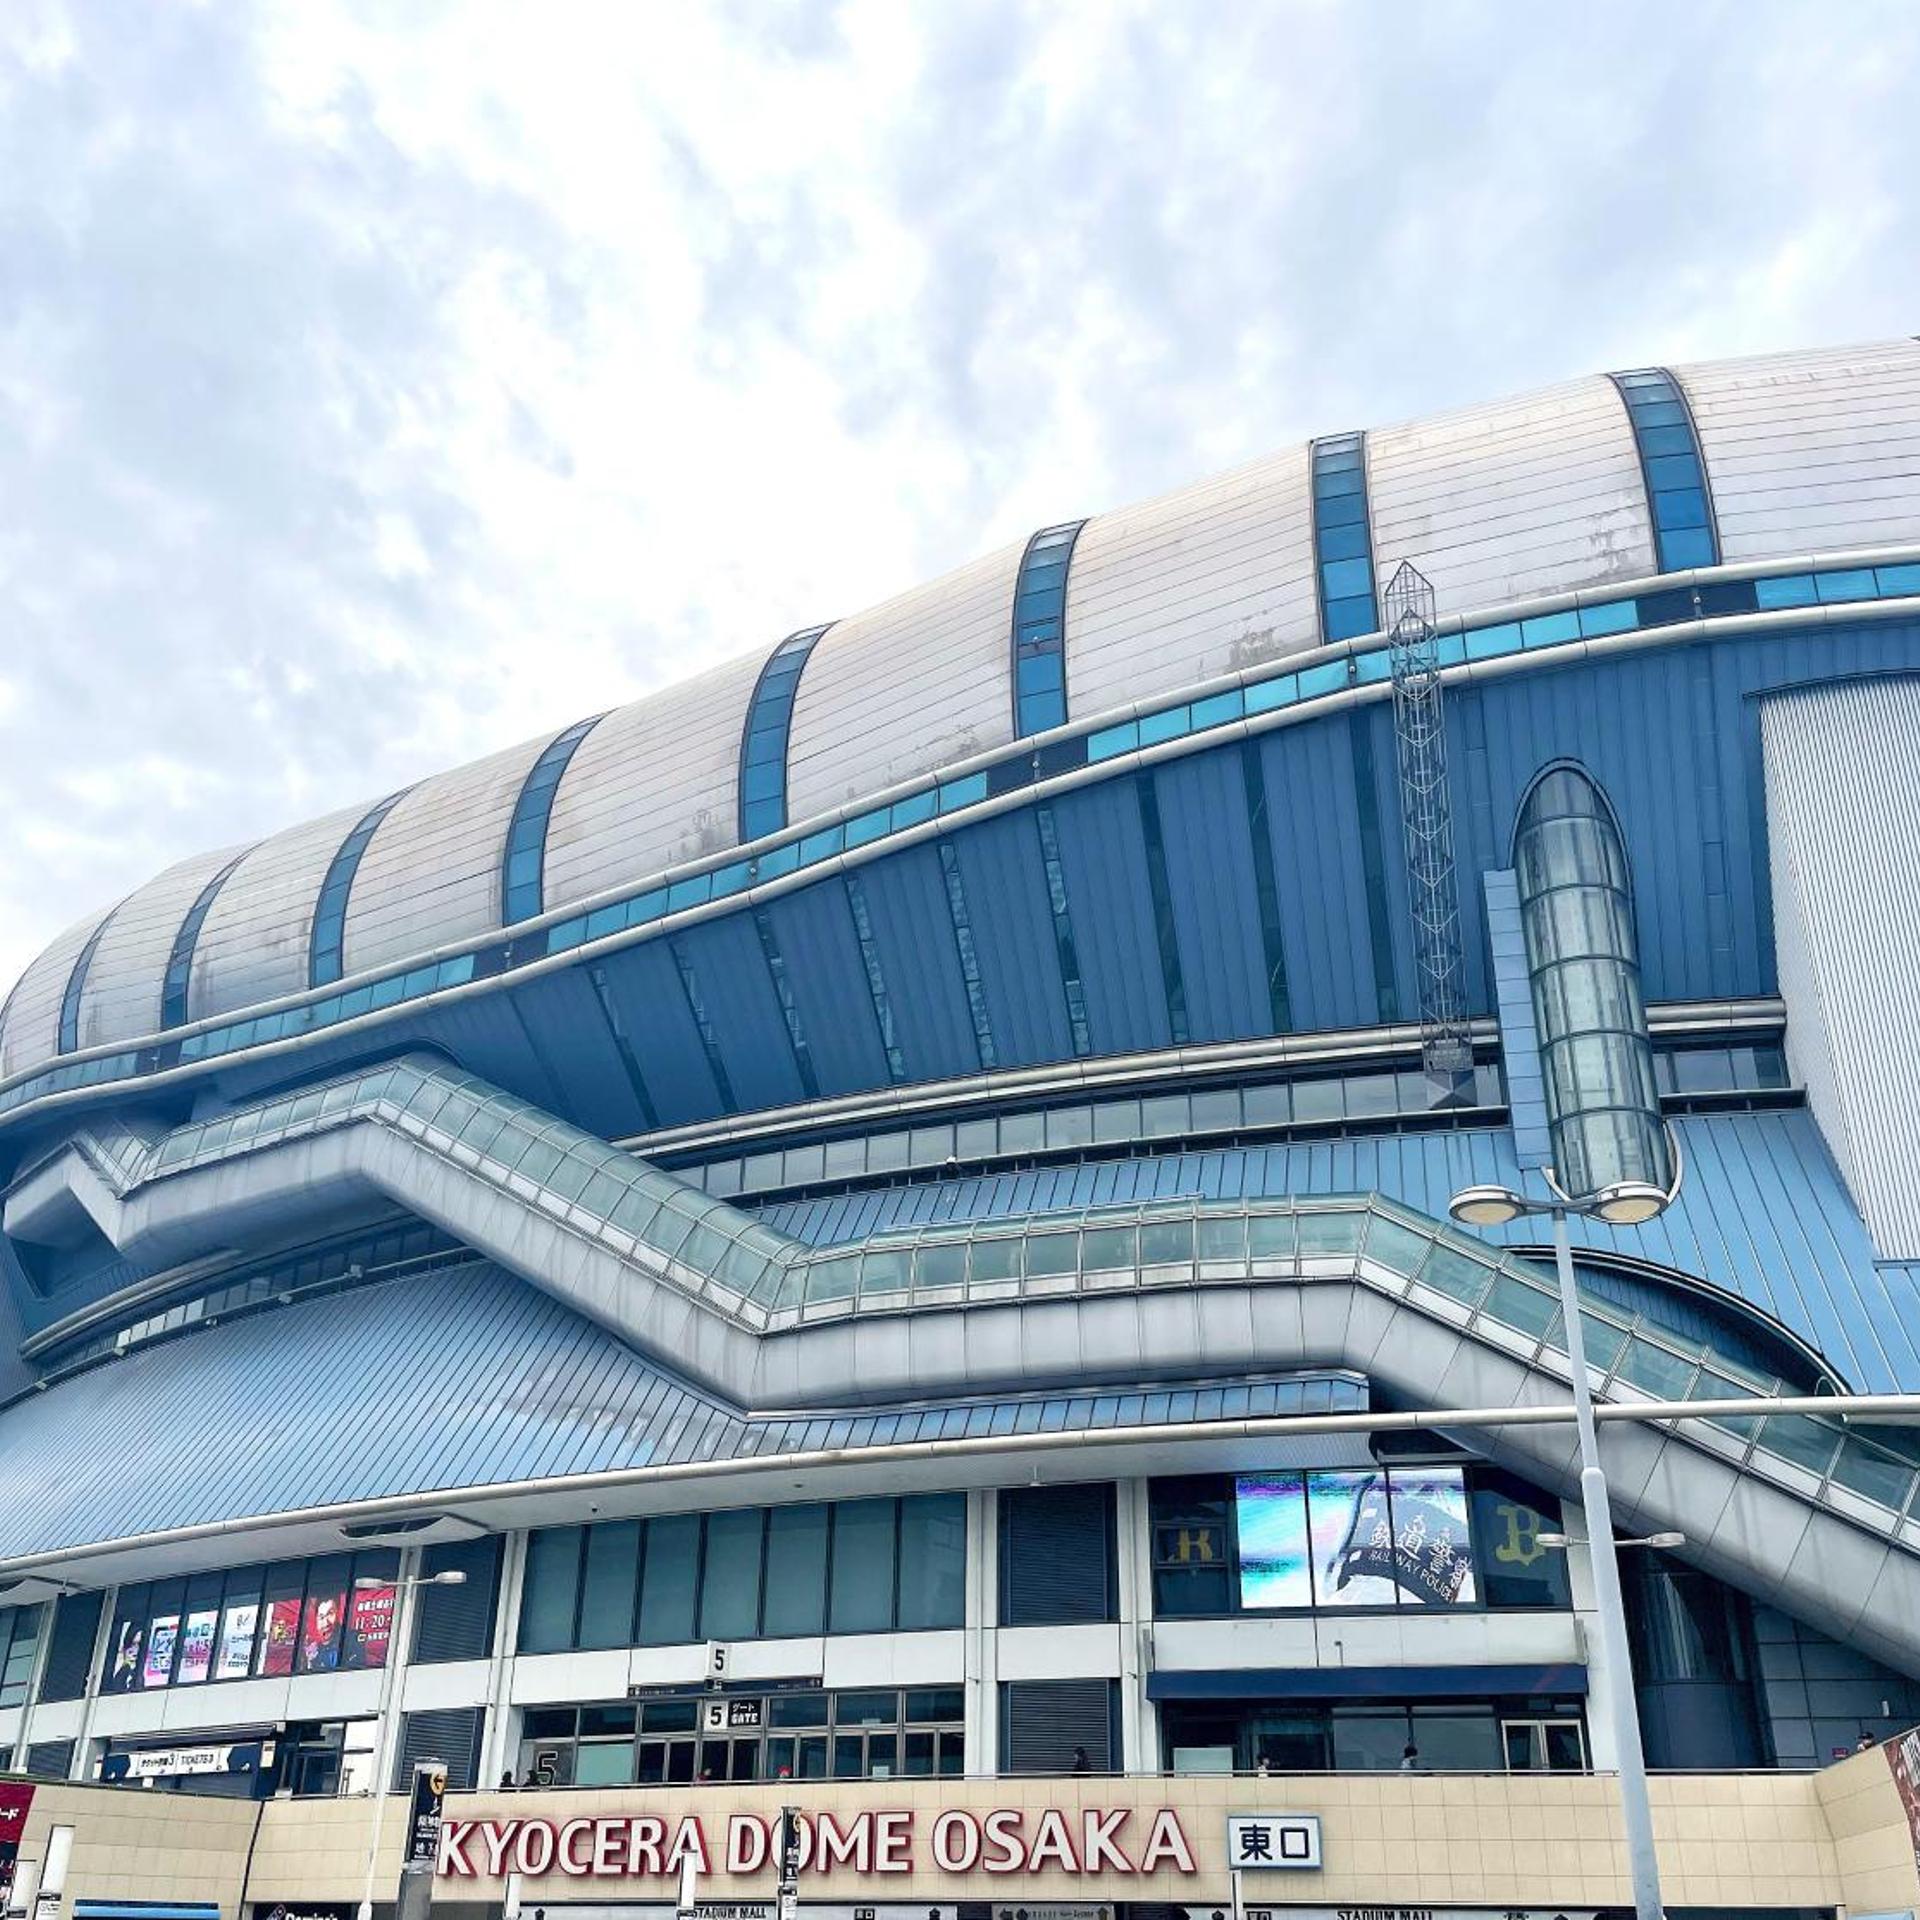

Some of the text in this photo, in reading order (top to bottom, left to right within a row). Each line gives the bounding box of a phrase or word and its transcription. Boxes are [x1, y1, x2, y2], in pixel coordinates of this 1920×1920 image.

[714, 1649, 725, 1671] 5
[710, 1706, 759, 1725] 5 GATE
[536, 1748, 558, 1790] 5
[436, 1809, 1197, 1876] KYOCERA DOME OSAKA
[1239, 1824, 1310, 1861] 東口
